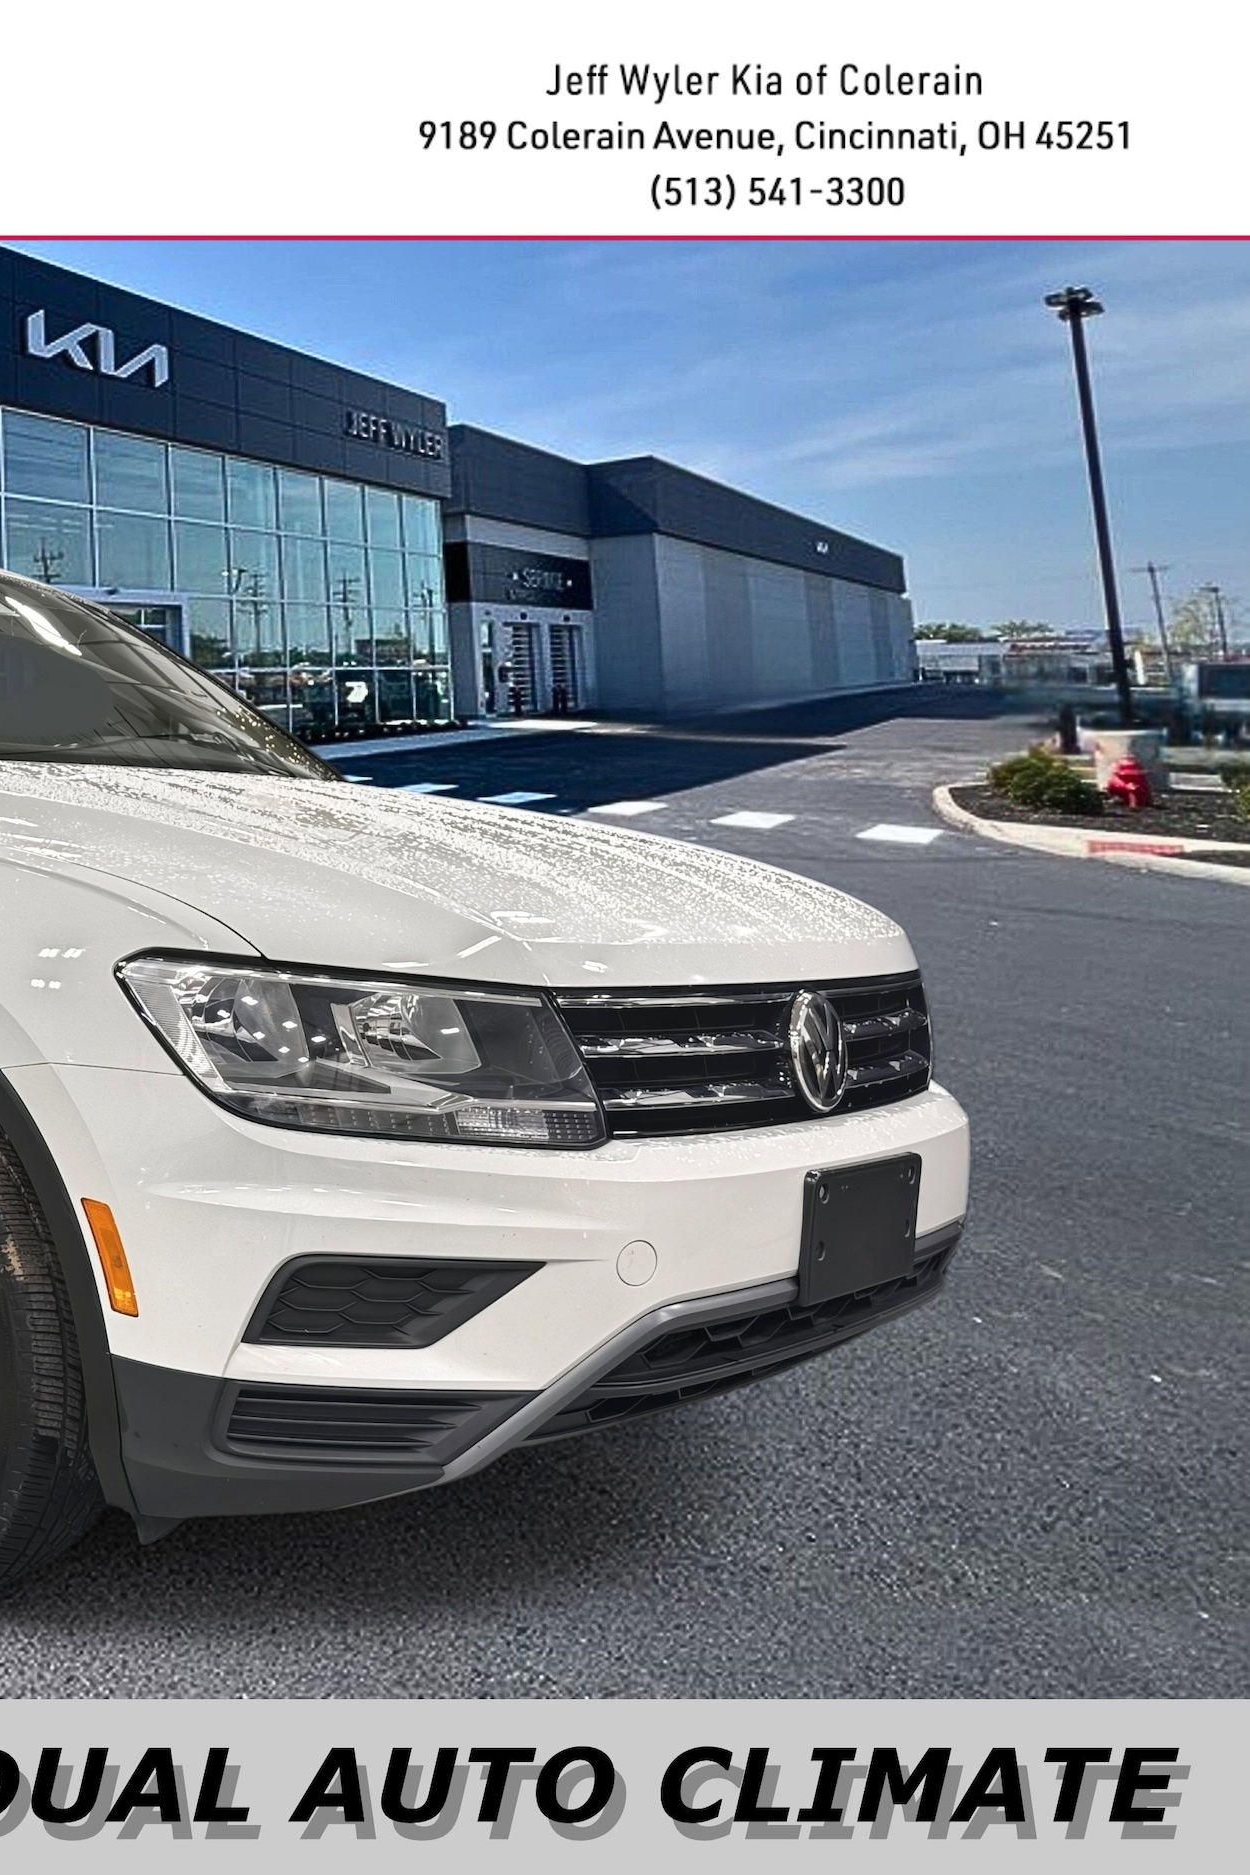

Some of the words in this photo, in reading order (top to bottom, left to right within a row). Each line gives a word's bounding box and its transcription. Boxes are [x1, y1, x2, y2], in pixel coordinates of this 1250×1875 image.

[27, 309, 169, 388] KIA
[348, 410, 388, 442] JEFF
[391, 420, 444, 458] WYLER
